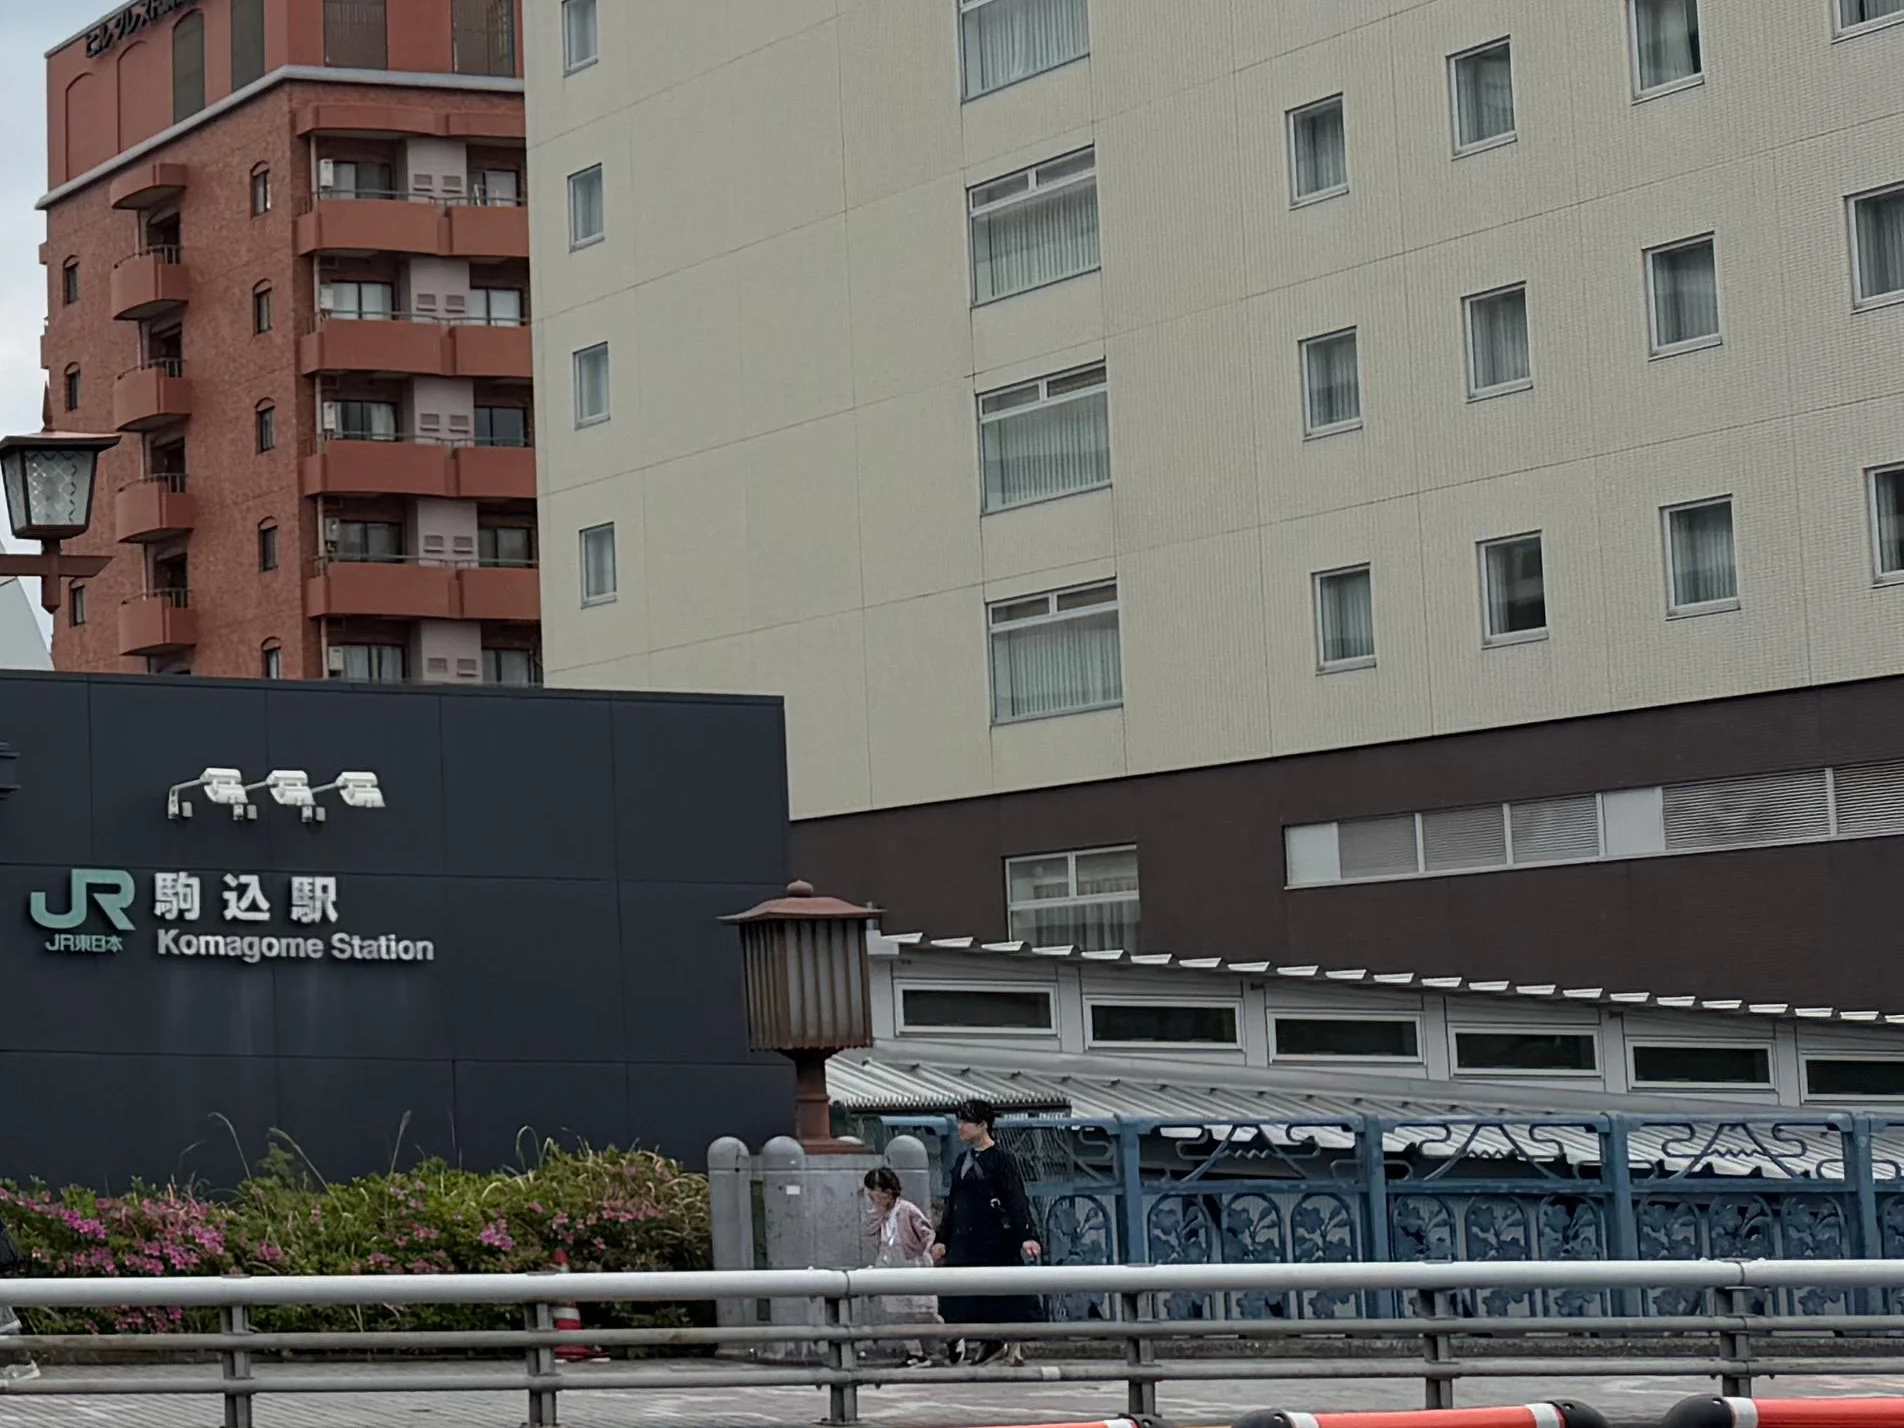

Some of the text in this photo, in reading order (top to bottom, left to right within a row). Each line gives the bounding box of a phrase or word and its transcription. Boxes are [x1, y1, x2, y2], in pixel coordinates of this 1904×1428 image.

[30, 869, 136, 930] JR
[154, 872, 338, 924] 駒込駅
[45, 934, 124, 952] JR東日本
[157, 929, 434, 963] Komagome Station
